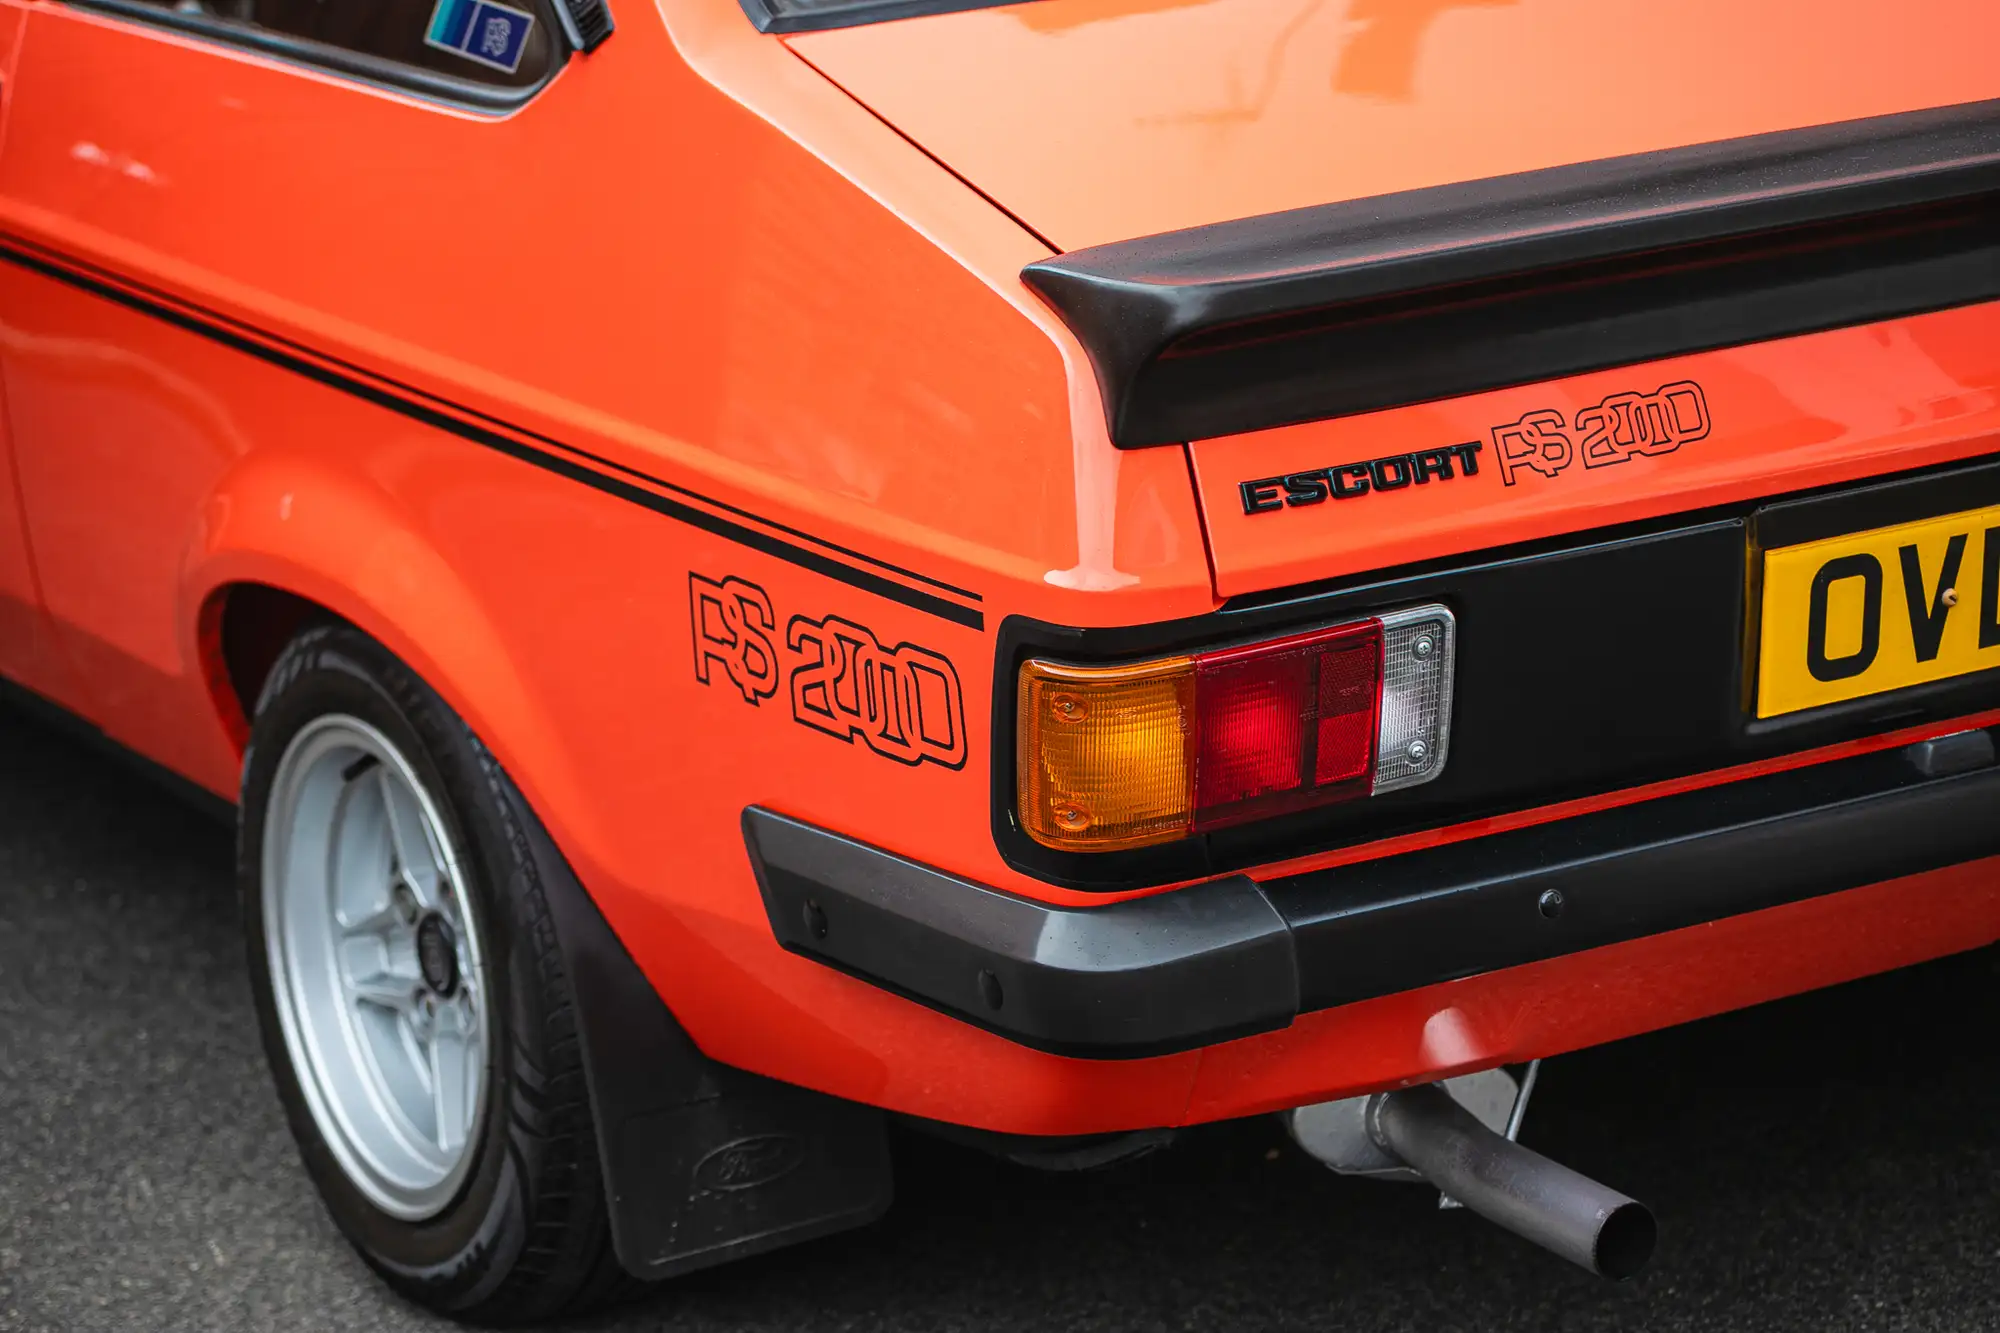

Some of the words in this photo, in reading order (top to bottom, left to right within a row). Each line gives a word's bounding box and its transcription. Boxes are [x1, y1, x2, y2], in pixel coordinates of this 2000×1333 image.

[1239, 441, 1482, 515] ESCORT
[1492, 409, 1572, 486] RS
[1576, 380, 1711, 470] 2000
[688, 570, 780, 708] RS
[786, 613, 969, 772] 2000
[1806, 526, 2000, 683] OV
